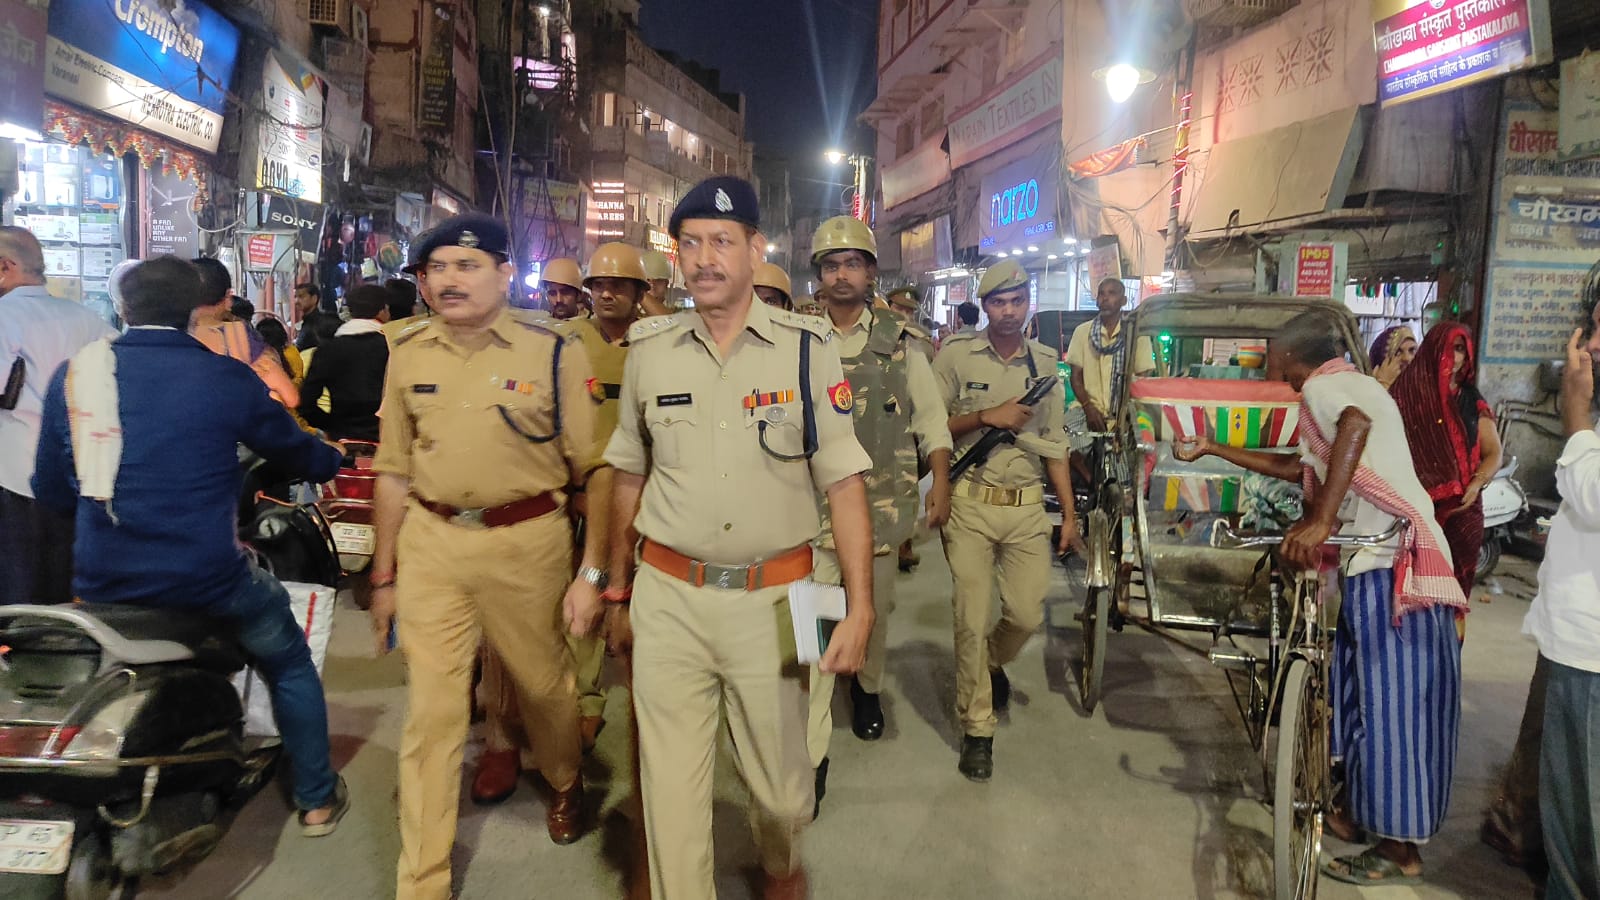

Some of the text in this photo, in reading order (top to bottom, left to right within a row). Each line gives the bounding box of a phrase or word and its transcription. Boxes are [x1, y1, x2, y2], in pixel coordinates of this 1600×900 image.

[114, 0, 204, 62] Crompton
[1418, 11, 1453, 38] संस्कृत
[1453, 0, 1516, 31] पुस्तकाल
[1458, 55, 1466, 70] के
[271, 211, 317, 230] SONY
[991, 178, 1040, 230] narzo
